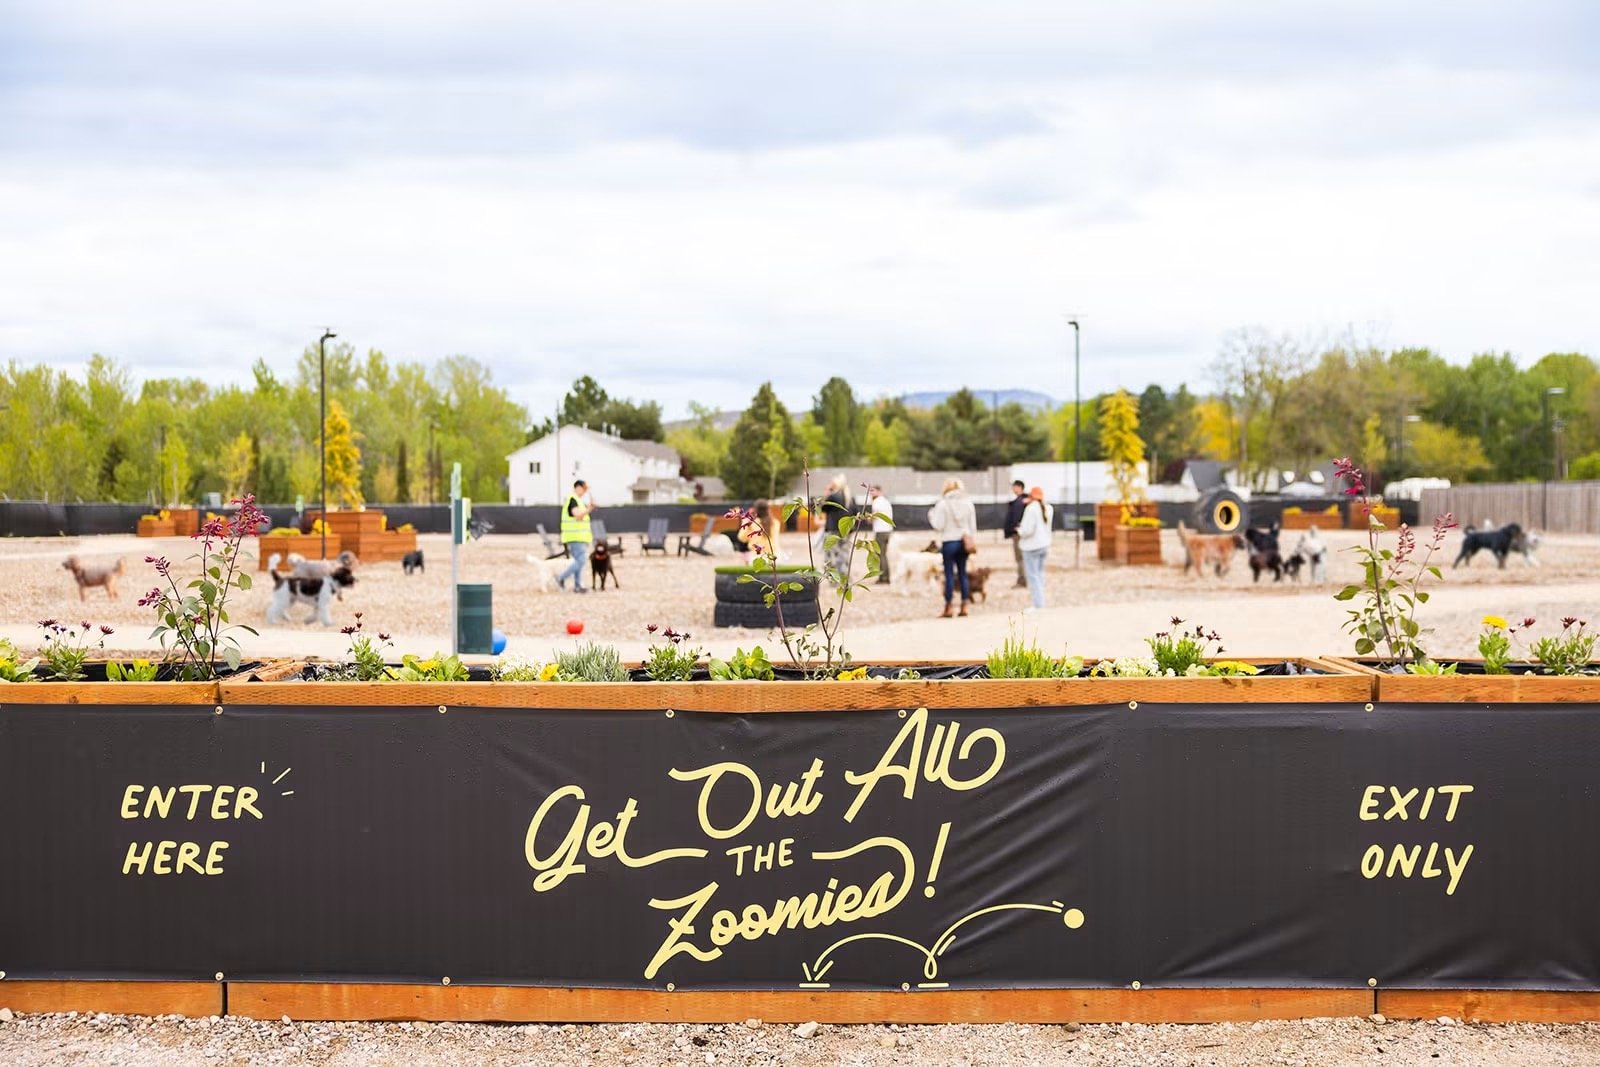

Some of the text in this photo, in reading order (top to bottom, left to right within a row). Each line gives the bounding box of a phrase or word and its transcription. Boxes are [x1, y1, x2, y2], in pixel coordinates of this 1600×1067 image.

[120, 784, 263, 821] ENTER
[524, 706, 1006, 892] Get Out All
[1359, 784, 1474, 822] EXIT
[122, 840, 230, 876] HERE
[725, 837, 795, 877] THE
[1360, 841, 1475, 896] ONLY
[644, 822, 952, 980] Zoomies!
